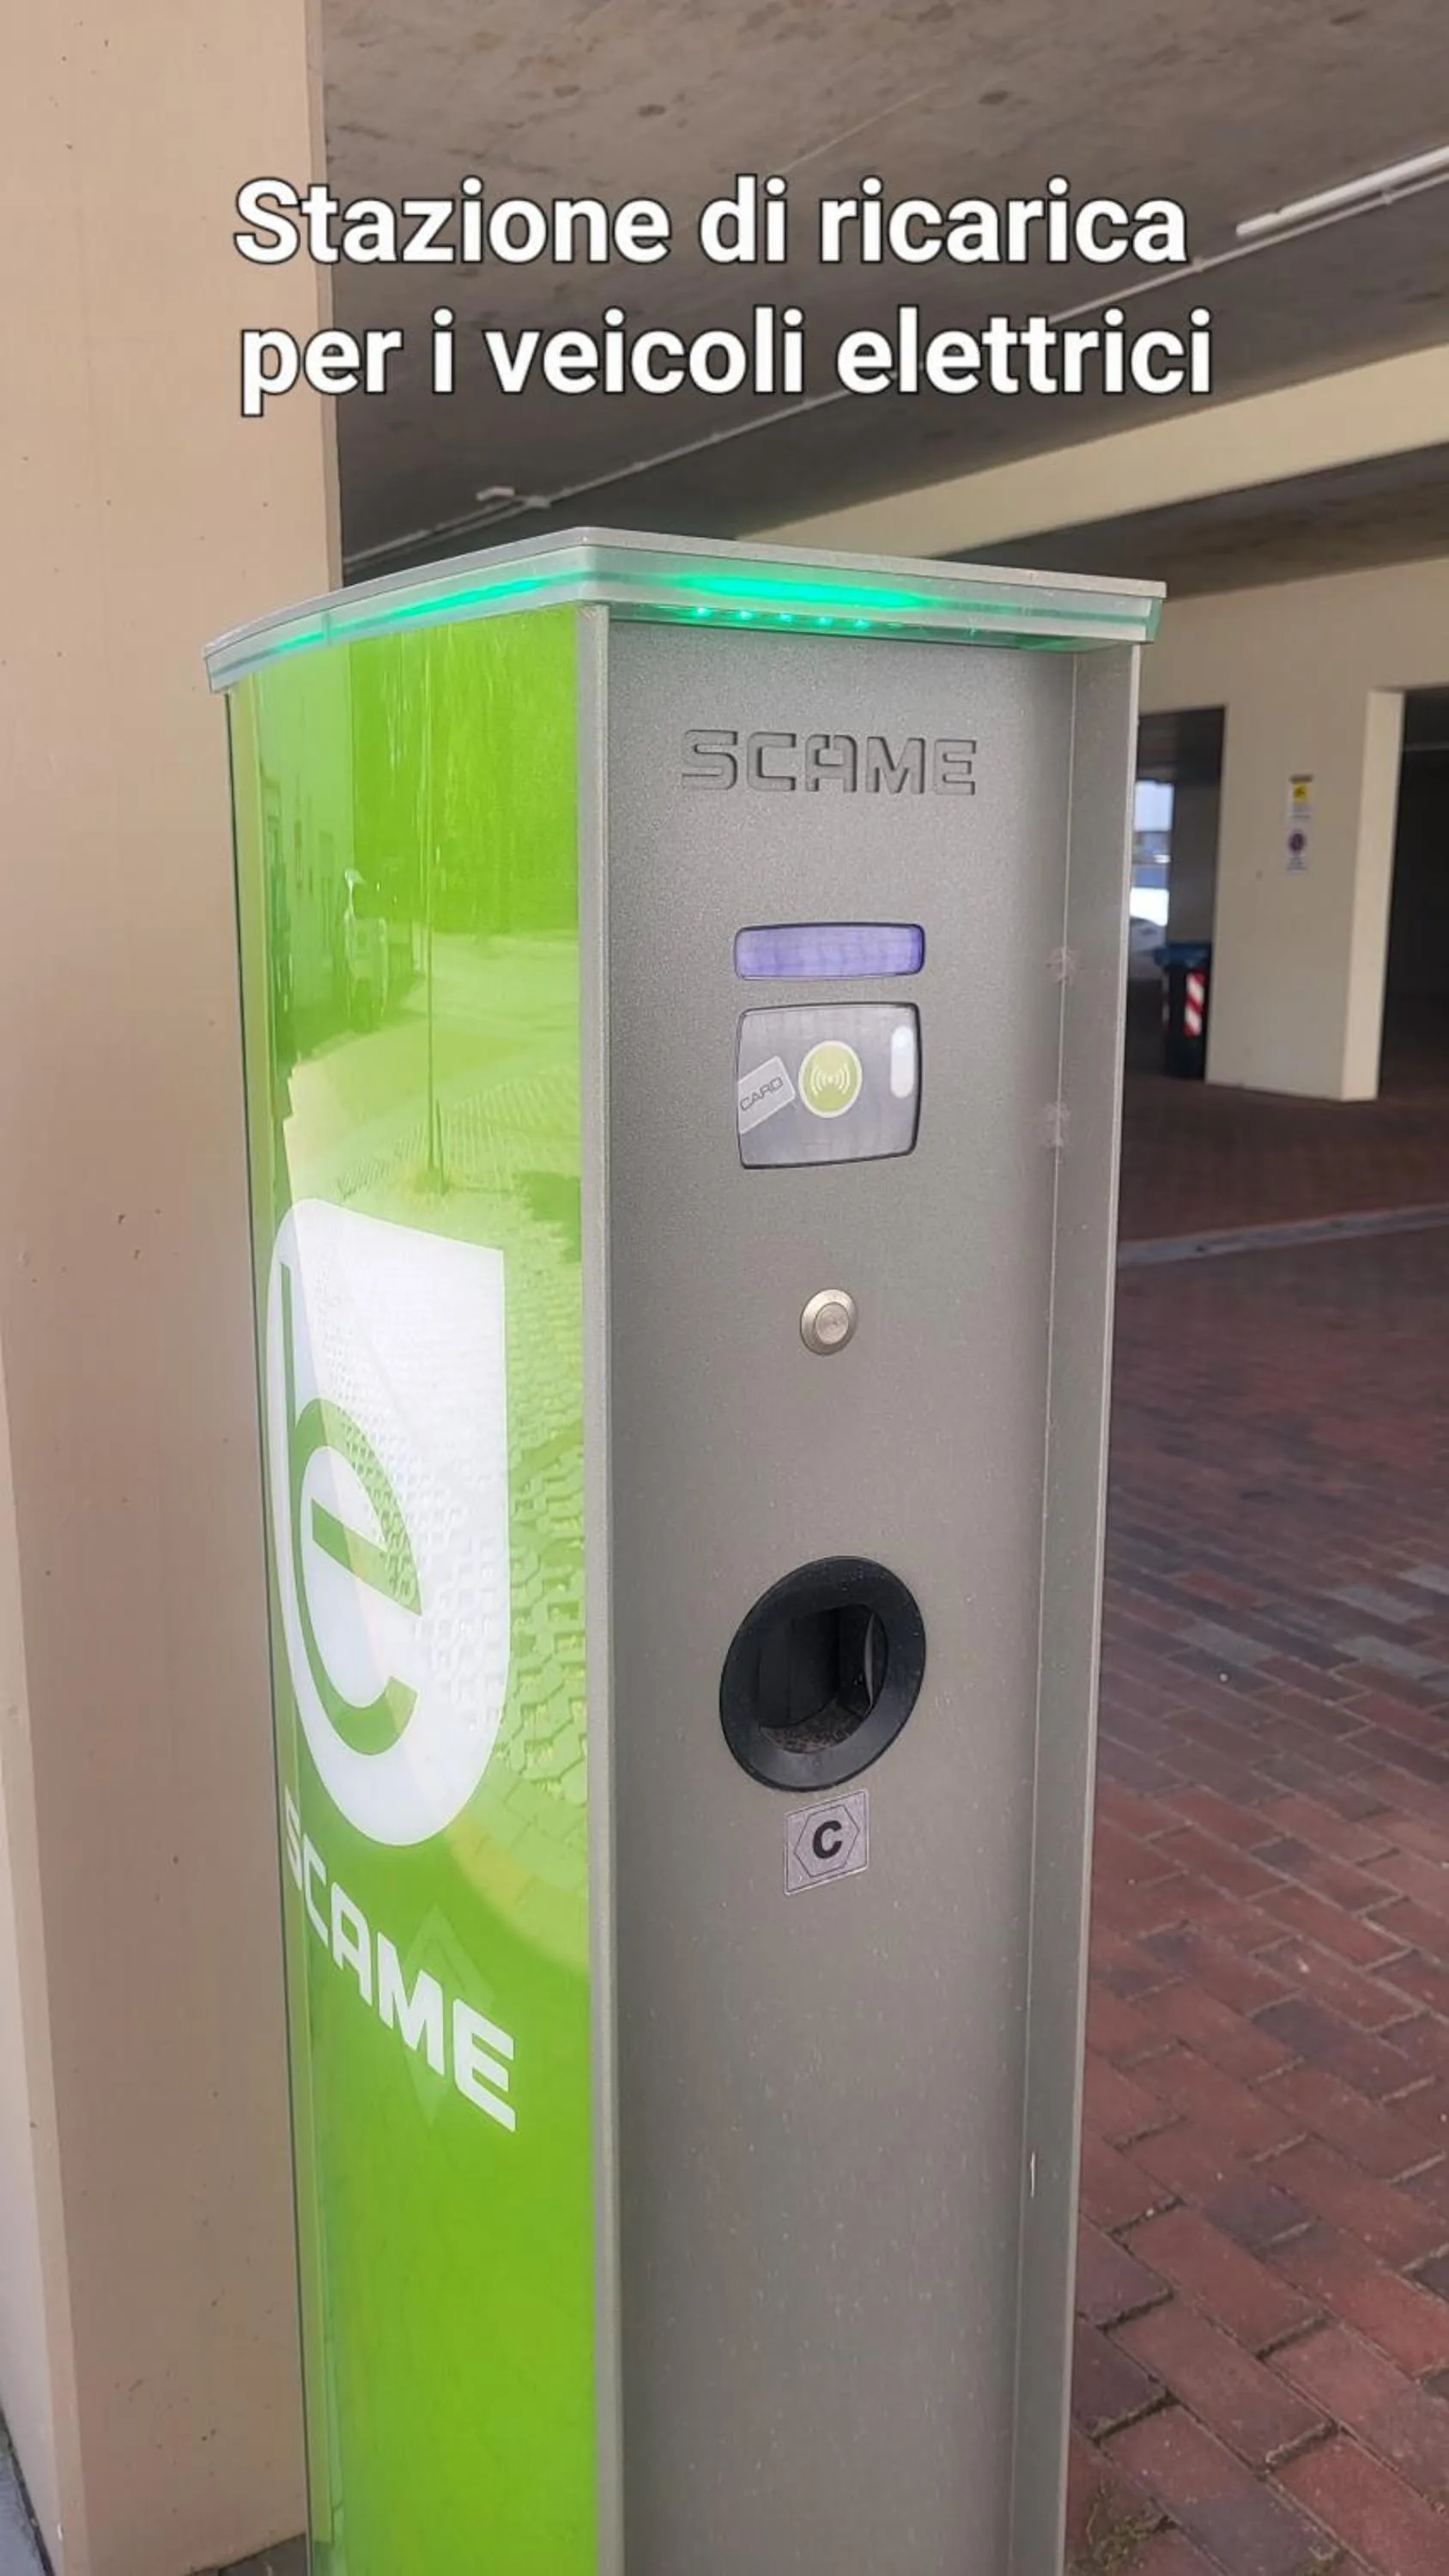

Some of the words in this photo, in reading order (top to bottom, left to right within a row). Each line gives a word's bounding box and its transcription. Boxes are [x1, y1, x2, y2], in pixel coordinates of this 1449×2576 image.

[682, 729, 979, 796] SCAME
[739, 1075, 784, 1112] CARD
[811, 1820, 843, 1860] C
[284, 1783, 517, 2133] SCAME
